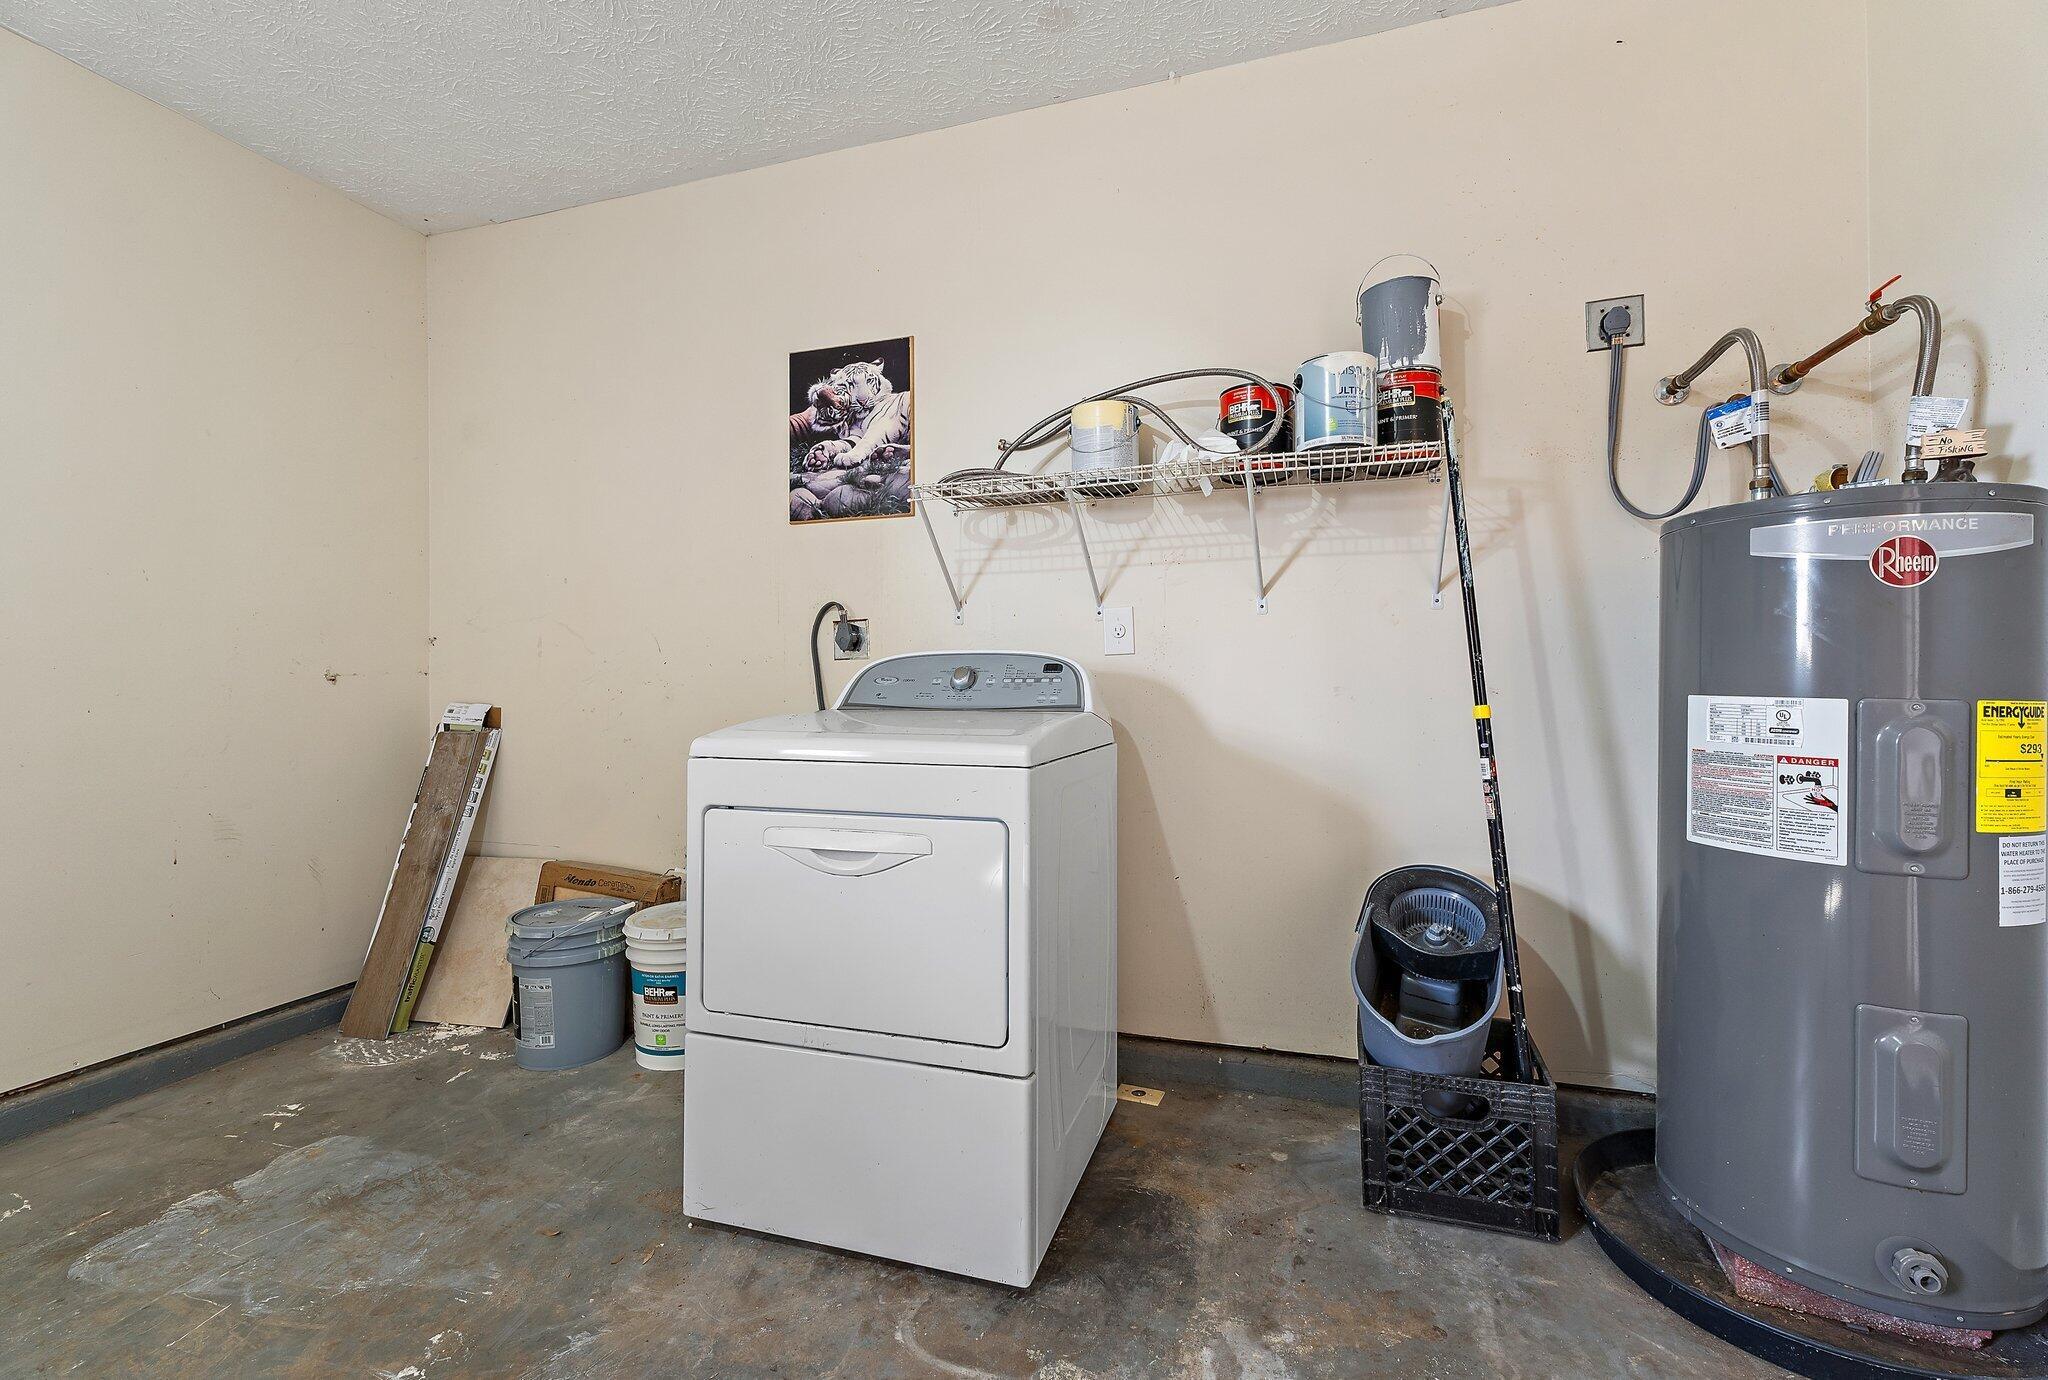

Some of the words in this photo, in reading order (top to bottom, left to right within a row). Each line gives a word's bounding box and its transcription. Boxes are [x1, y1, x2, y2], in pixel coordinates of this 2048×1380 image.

[1230, 402, 1250, 414] BEHR
[1828, 518, 1978, 536] PERFORMANCE
[1878, 538, 1934, 579] Rheem
[1790, 757, 1835, 766] DANGER
[564, 874, 596, 886] Mondo
[644, 986, 665, 996] BEHR
